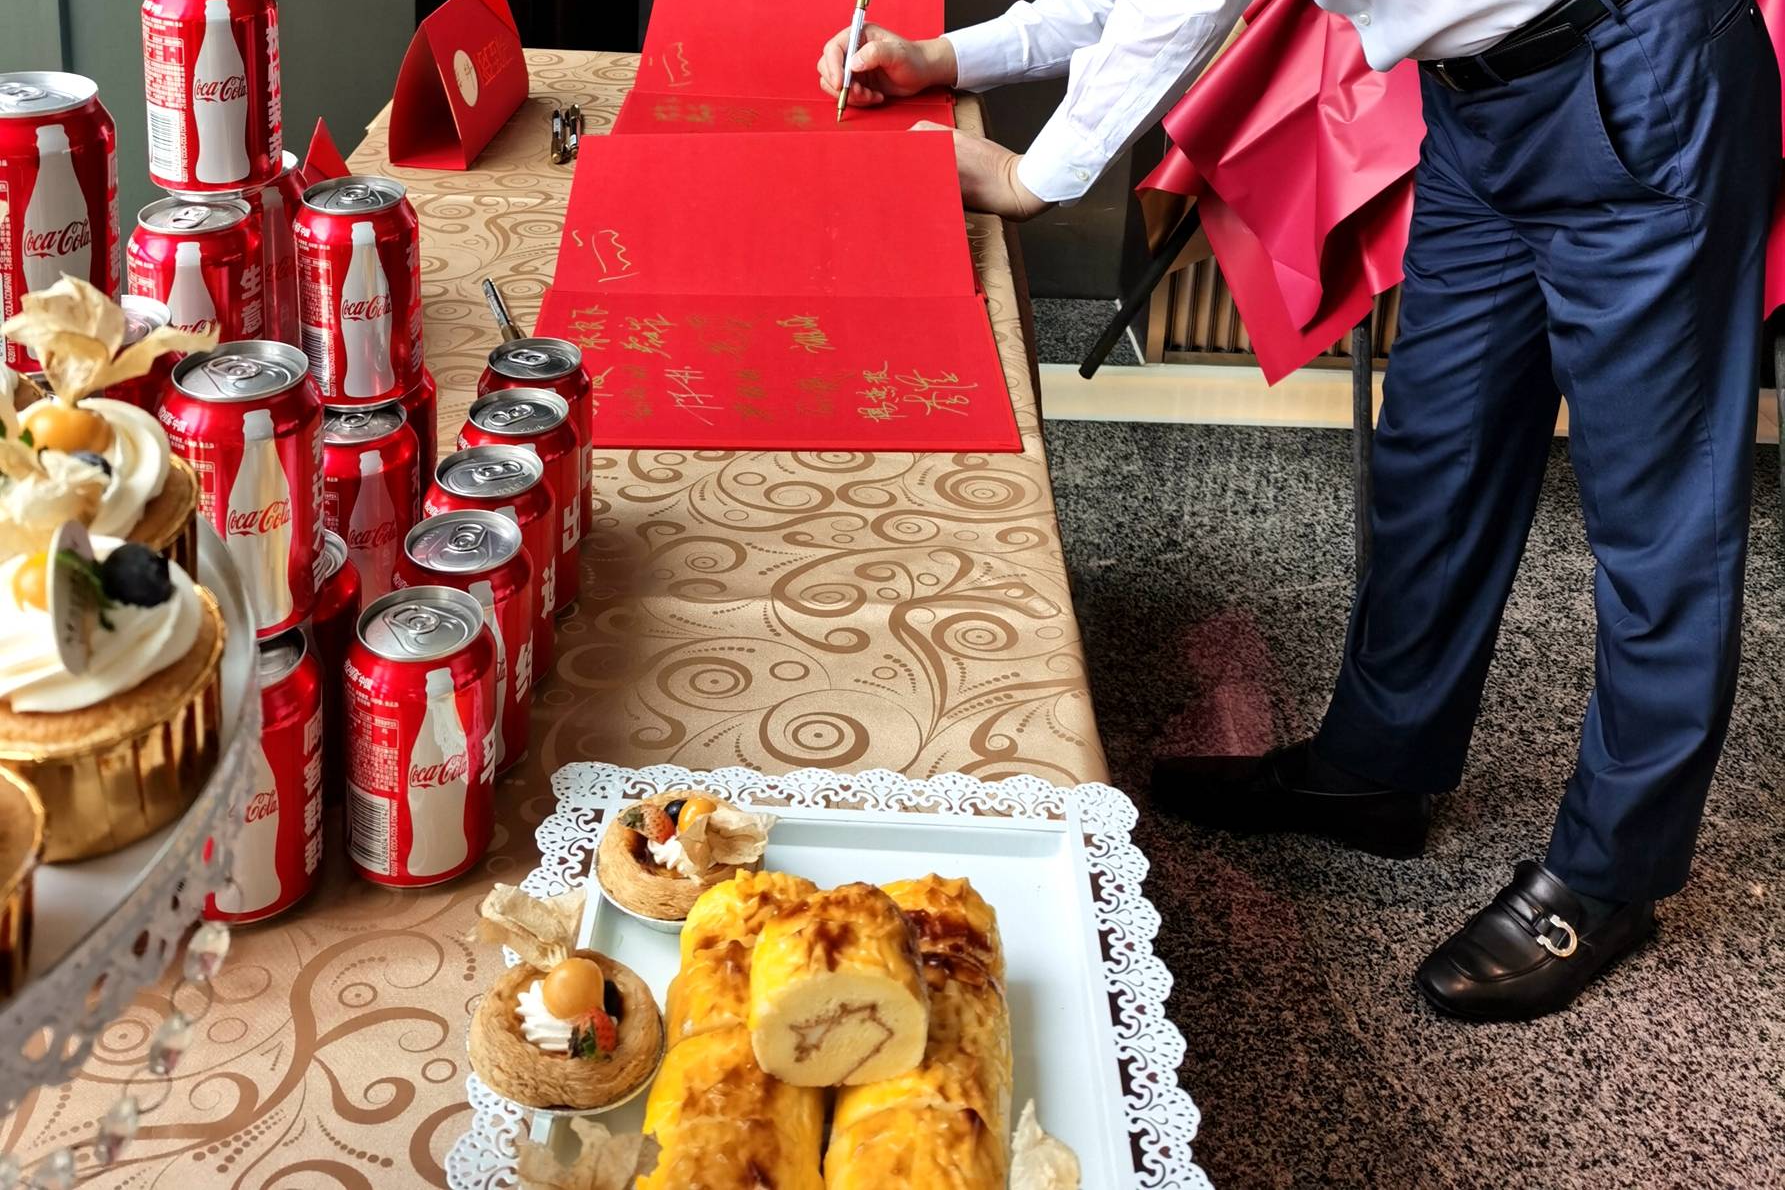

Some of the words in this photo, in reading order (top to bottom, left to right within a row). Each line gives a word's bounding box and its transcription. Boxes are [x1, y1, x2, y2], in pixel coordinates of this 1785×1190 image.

[194, 75, 248, 102] Coca-Cola
[24, 220, 92, 258] Coca-Cola
[342, 295, 392, 321] Coca-Cola
[228, 498, 291, 536] Coca-Cola
[349, 522, 398, 550] Coca-Cola
[410, 751, 467, 788] Coca-Cola
